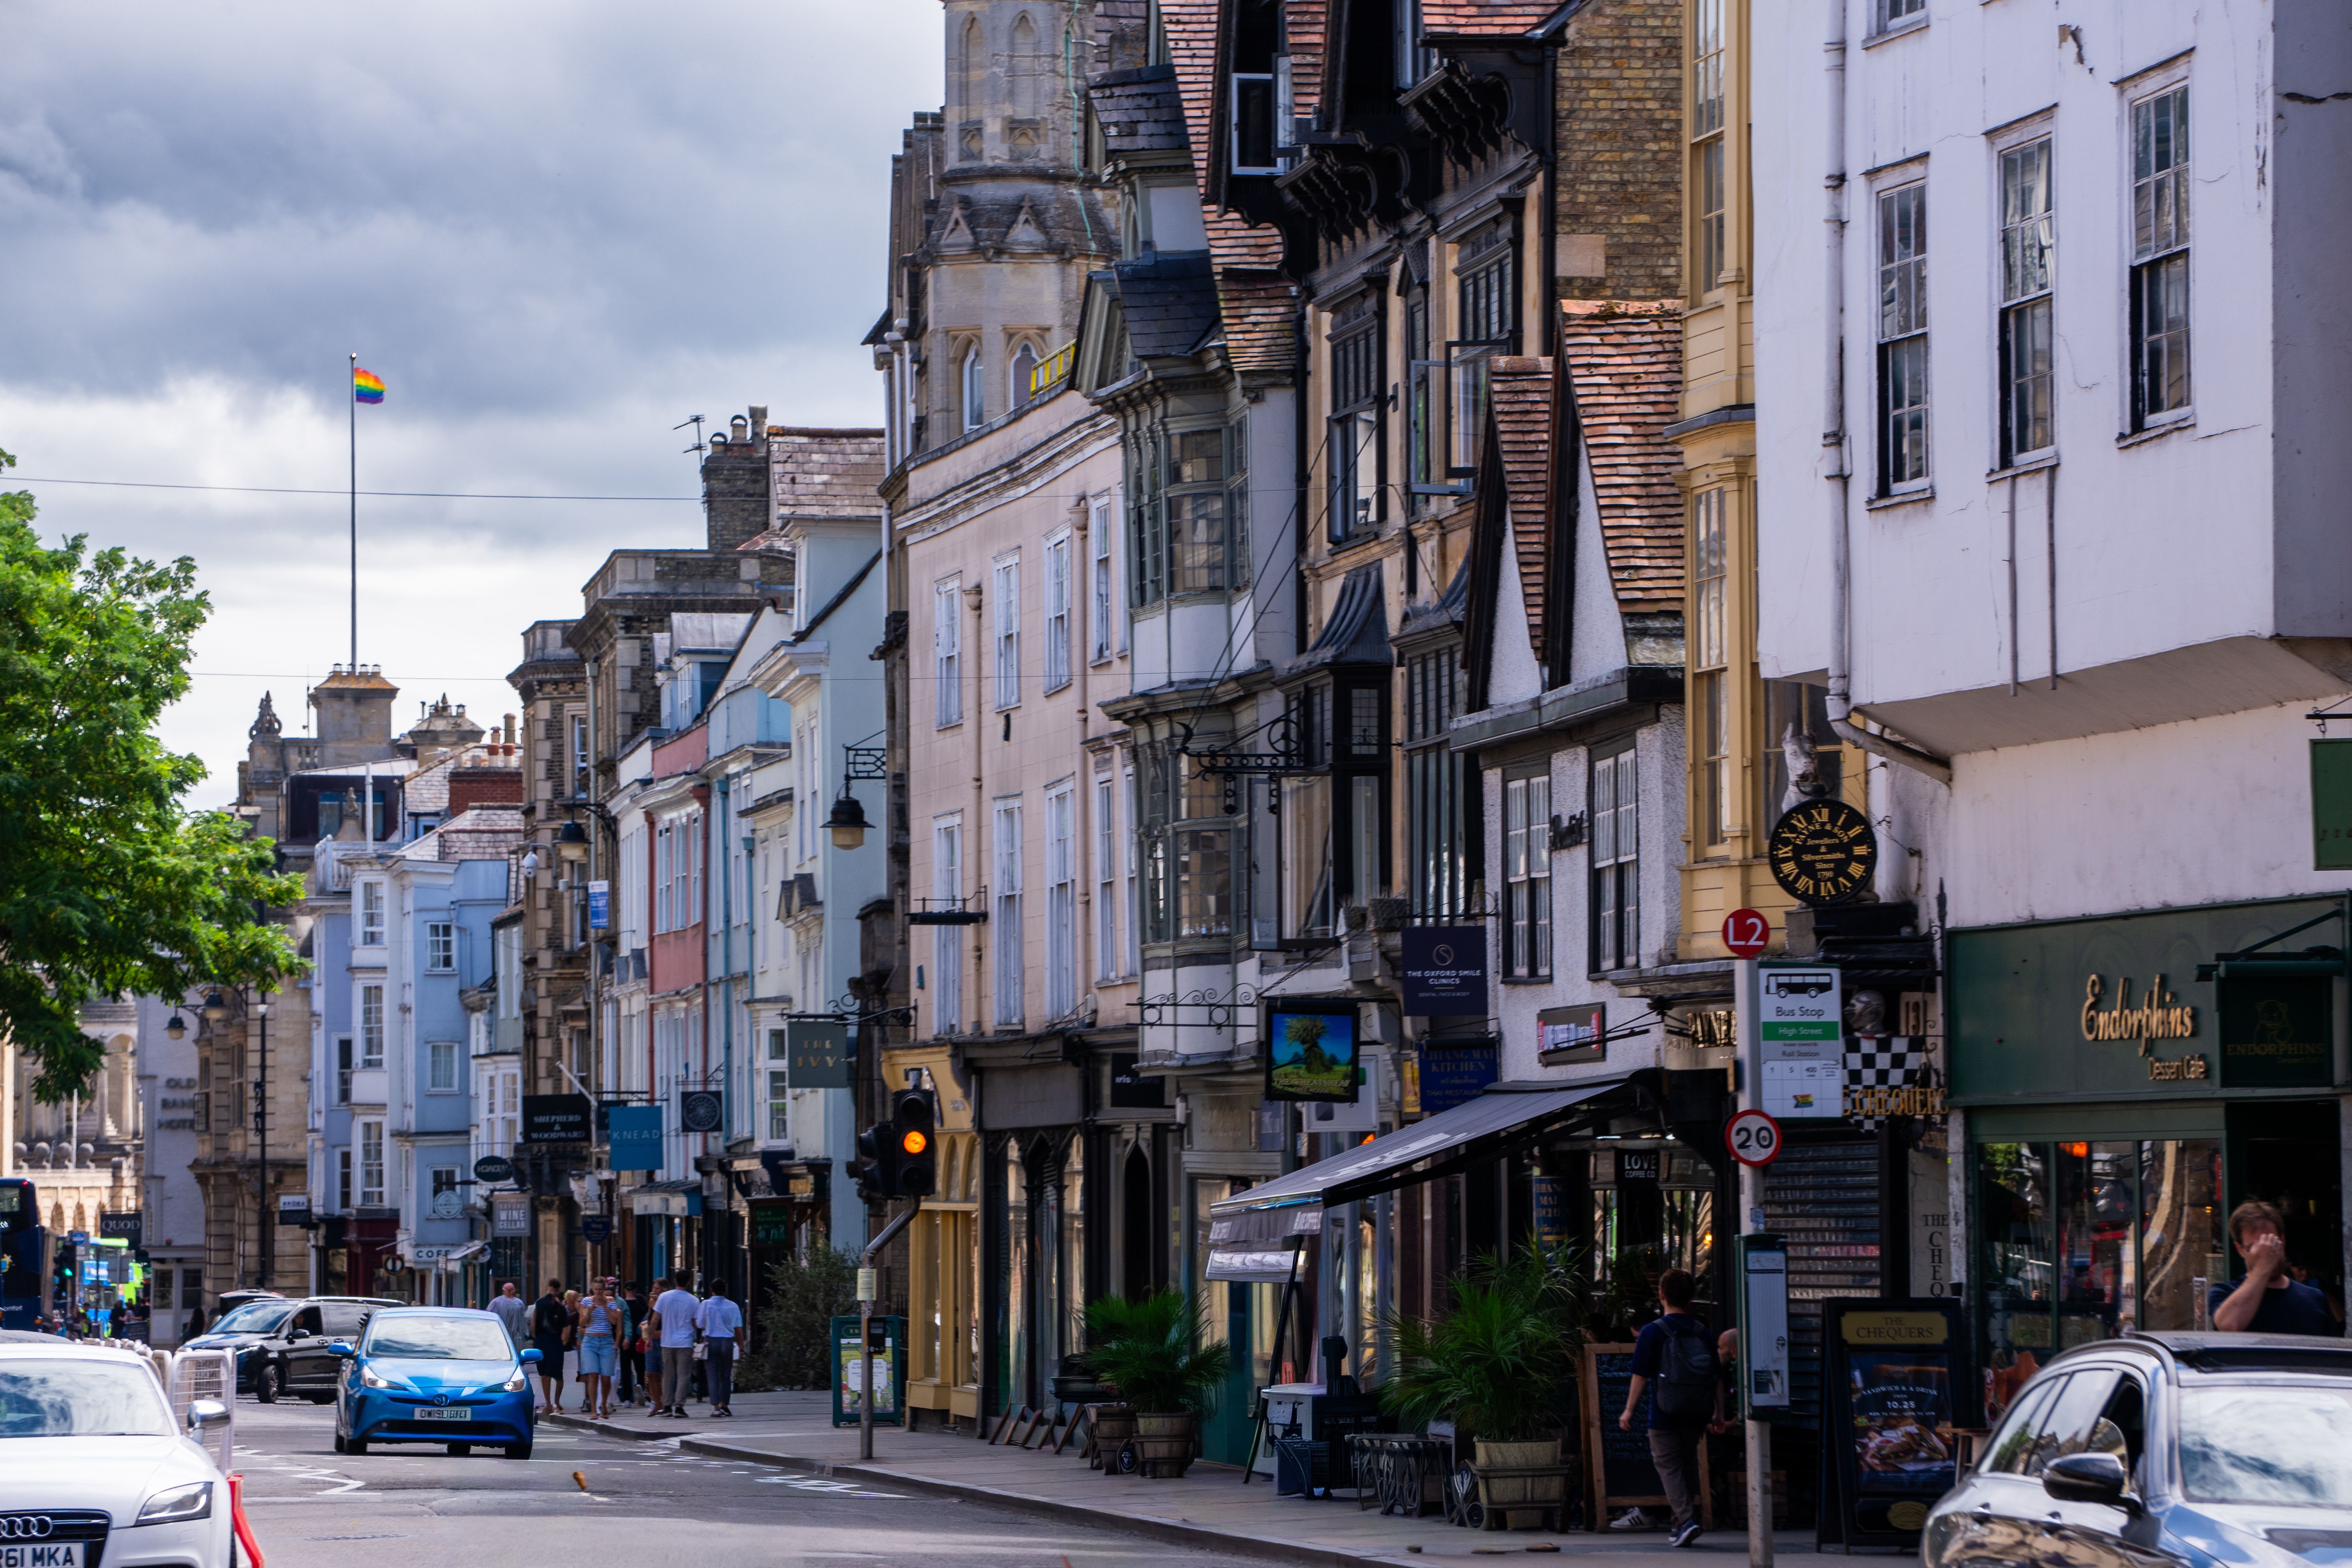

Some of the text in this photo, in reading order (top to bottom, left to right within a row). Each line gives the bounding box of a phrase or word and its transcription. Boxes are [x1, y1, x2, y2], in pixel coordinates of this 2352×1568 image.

[1795, 822, 1822, 845] PAYNE
[1832, 826, 1851, 843] SON
[1802, 852, 1847, 861] Silversmiths
[1818, 871, 1835, 881] 1790
[1728, 917, 1766, 945] L2
[1775, 1006, 1825, 1020] Bus Stop
[2081, 974, 2197, 1057] Endorphins
[1778, 1027, 1797, 1037] High
[802, 1039, 833, 1049] THE
[2226, 1043, 2324, 1056] ENDORPHINS
[1421, 1049, 1494, 1061] CHIANG MAI
[797, 1055, 838, 1068] IVY
[1431, 1061, 1486, 1072] KITCHEN
[166, 1078, 197, 1089] OLD
[1293, 1078, 1351, 1087] WHEATSHEAF
[1855, 1088, 1949, 1116] CHEQUERS
[533, 1114, 581, 1123] SHEPHERD
[158, 1119, 194, 1130] HOTE
[531, 1130, 586, 1140] WOODWARD
[612, 1130, 660, 1140] KNEAD
[1735, 1126, 1774, 1150] 20
[1624, 1154, 1657, 1170] LOVE
[499, 1209, 526, 1220] WINE
[1922, 1214, 1949, 1227] THE
[102, 1220, 141, 1233] QUOD
[416, 1250, 450, 1258] COFF
[1928, 1231, 1944, 1298] CHEQ
[1883, 1317, 1905, 1326] THE
[1856, 1327, 1934, 1341] CHEQUERS
[1886, 1400, 1916, 1409] 10.25
[0, 1546, 75, 1568] 61 MKA
